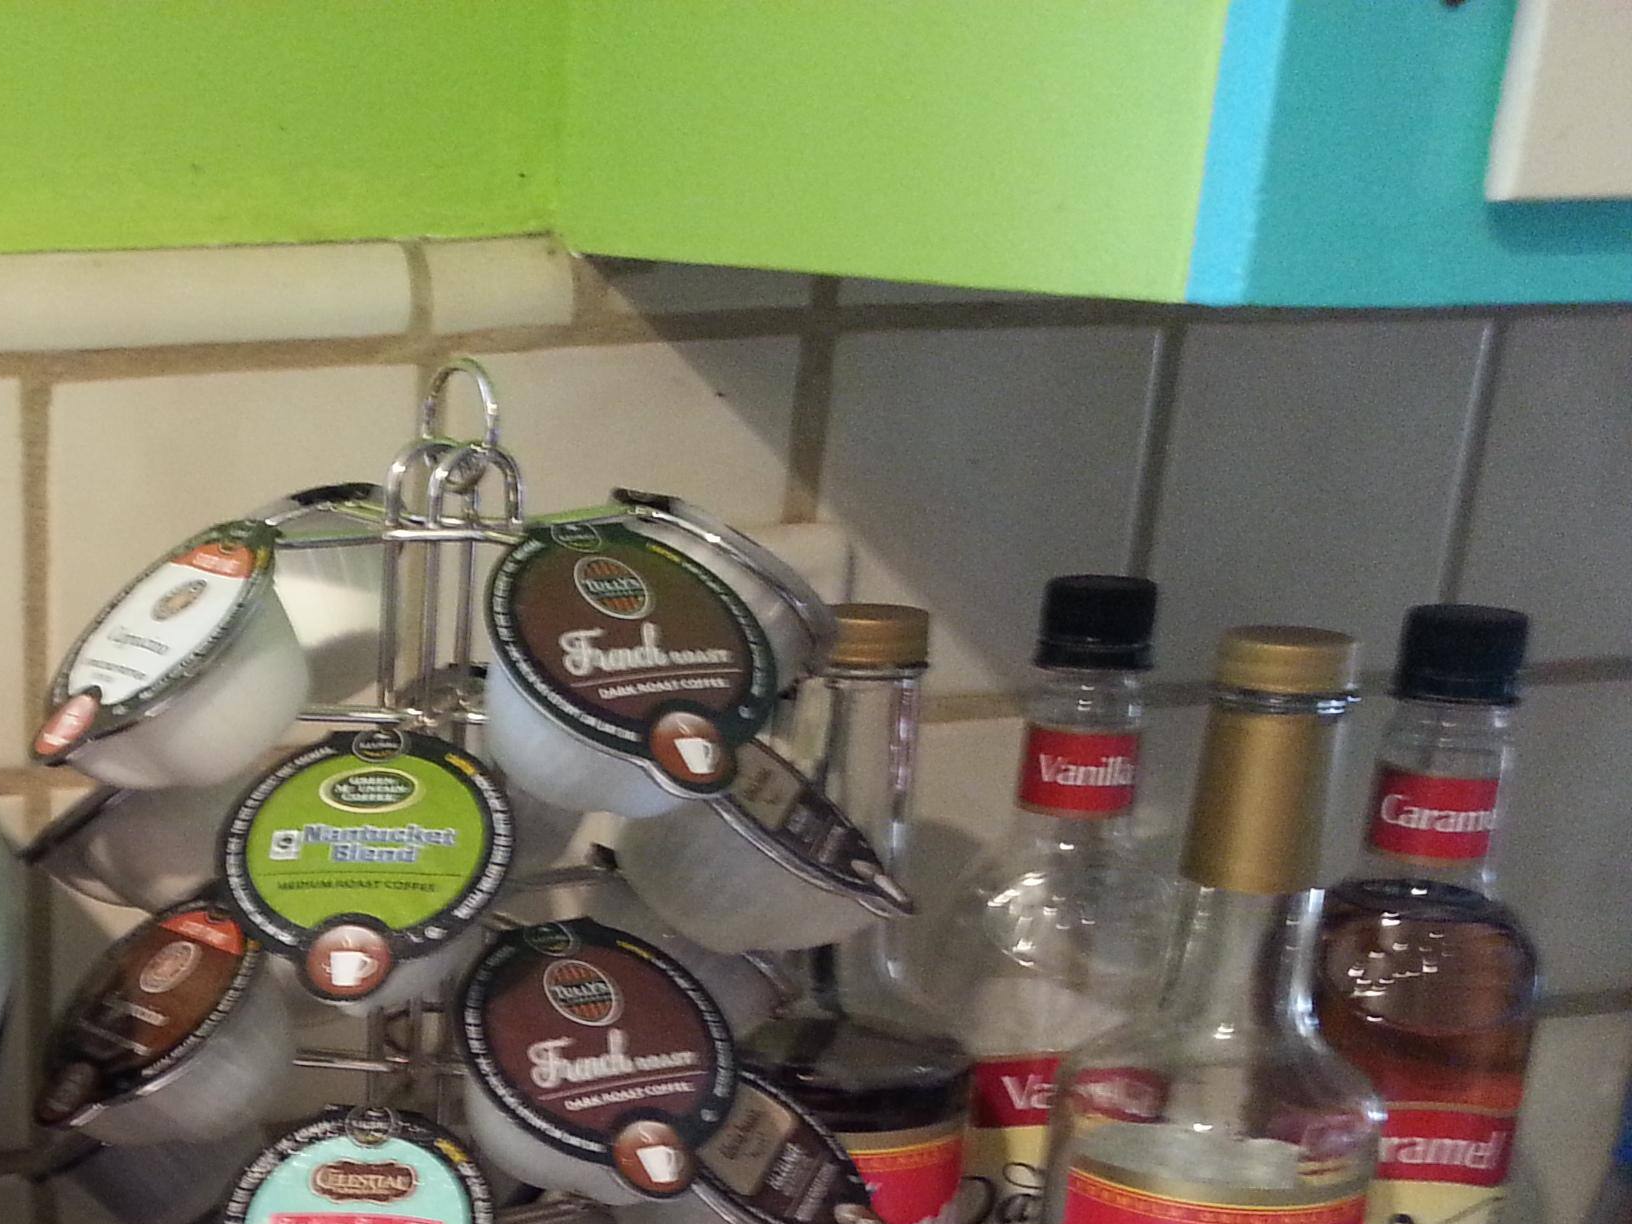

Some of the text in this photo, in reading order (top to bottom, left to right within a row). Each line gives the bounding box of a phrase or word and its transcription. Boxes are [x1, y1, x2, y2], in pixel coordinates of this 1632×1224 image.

[559, 622, 668, 677] French
[304, 823, 457, 848] Nantucket
[331, 843, 418, 862] Blend
[527, 1029, 634, 1088] French
